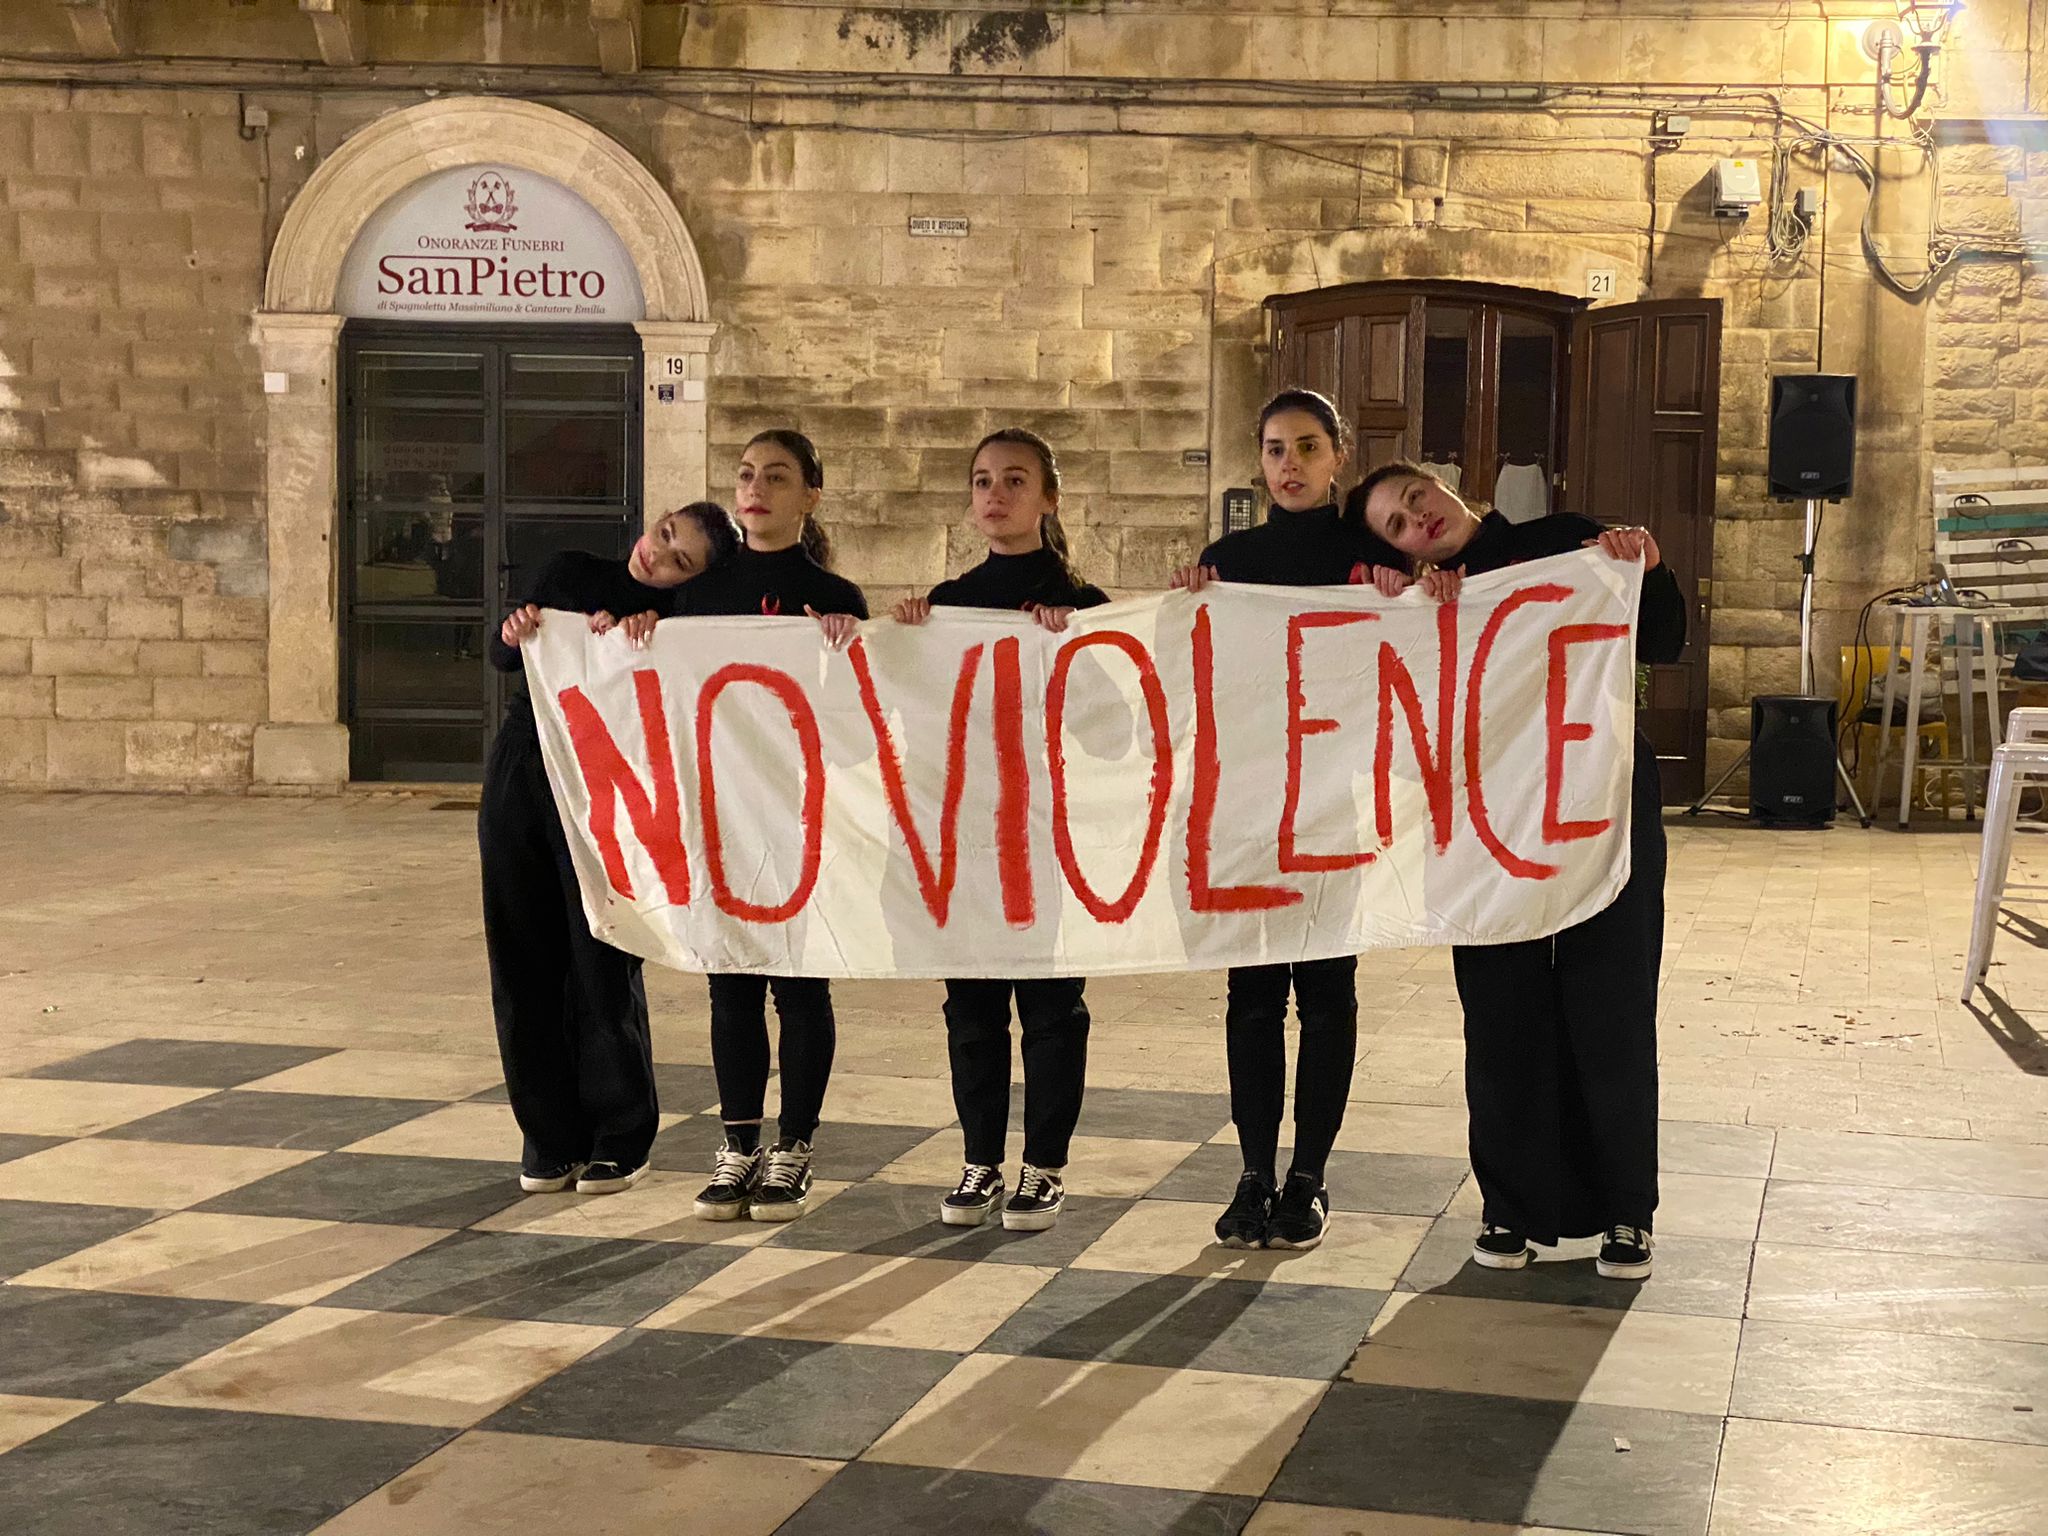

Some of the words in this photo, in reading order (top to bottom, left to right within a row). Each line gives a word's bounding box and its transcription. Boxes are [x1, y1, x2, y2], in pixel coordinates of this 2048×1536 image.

[417, 235, 498, 251] ONORANZE
[501, 237, 565, 252] FUNEBRI
[378, 254, 605, 299] SanPietro
[1592, 275, 1609, 292] 21
[377, 300, 388, 311] di
[448, 302, 514, 313] Massimiliano
[514, 303, 523, 313] &
[524, 303, 574, 314] Cantatore
[574, 304, 606, 315] Emilia
[666, 358, 683, 375] 19
